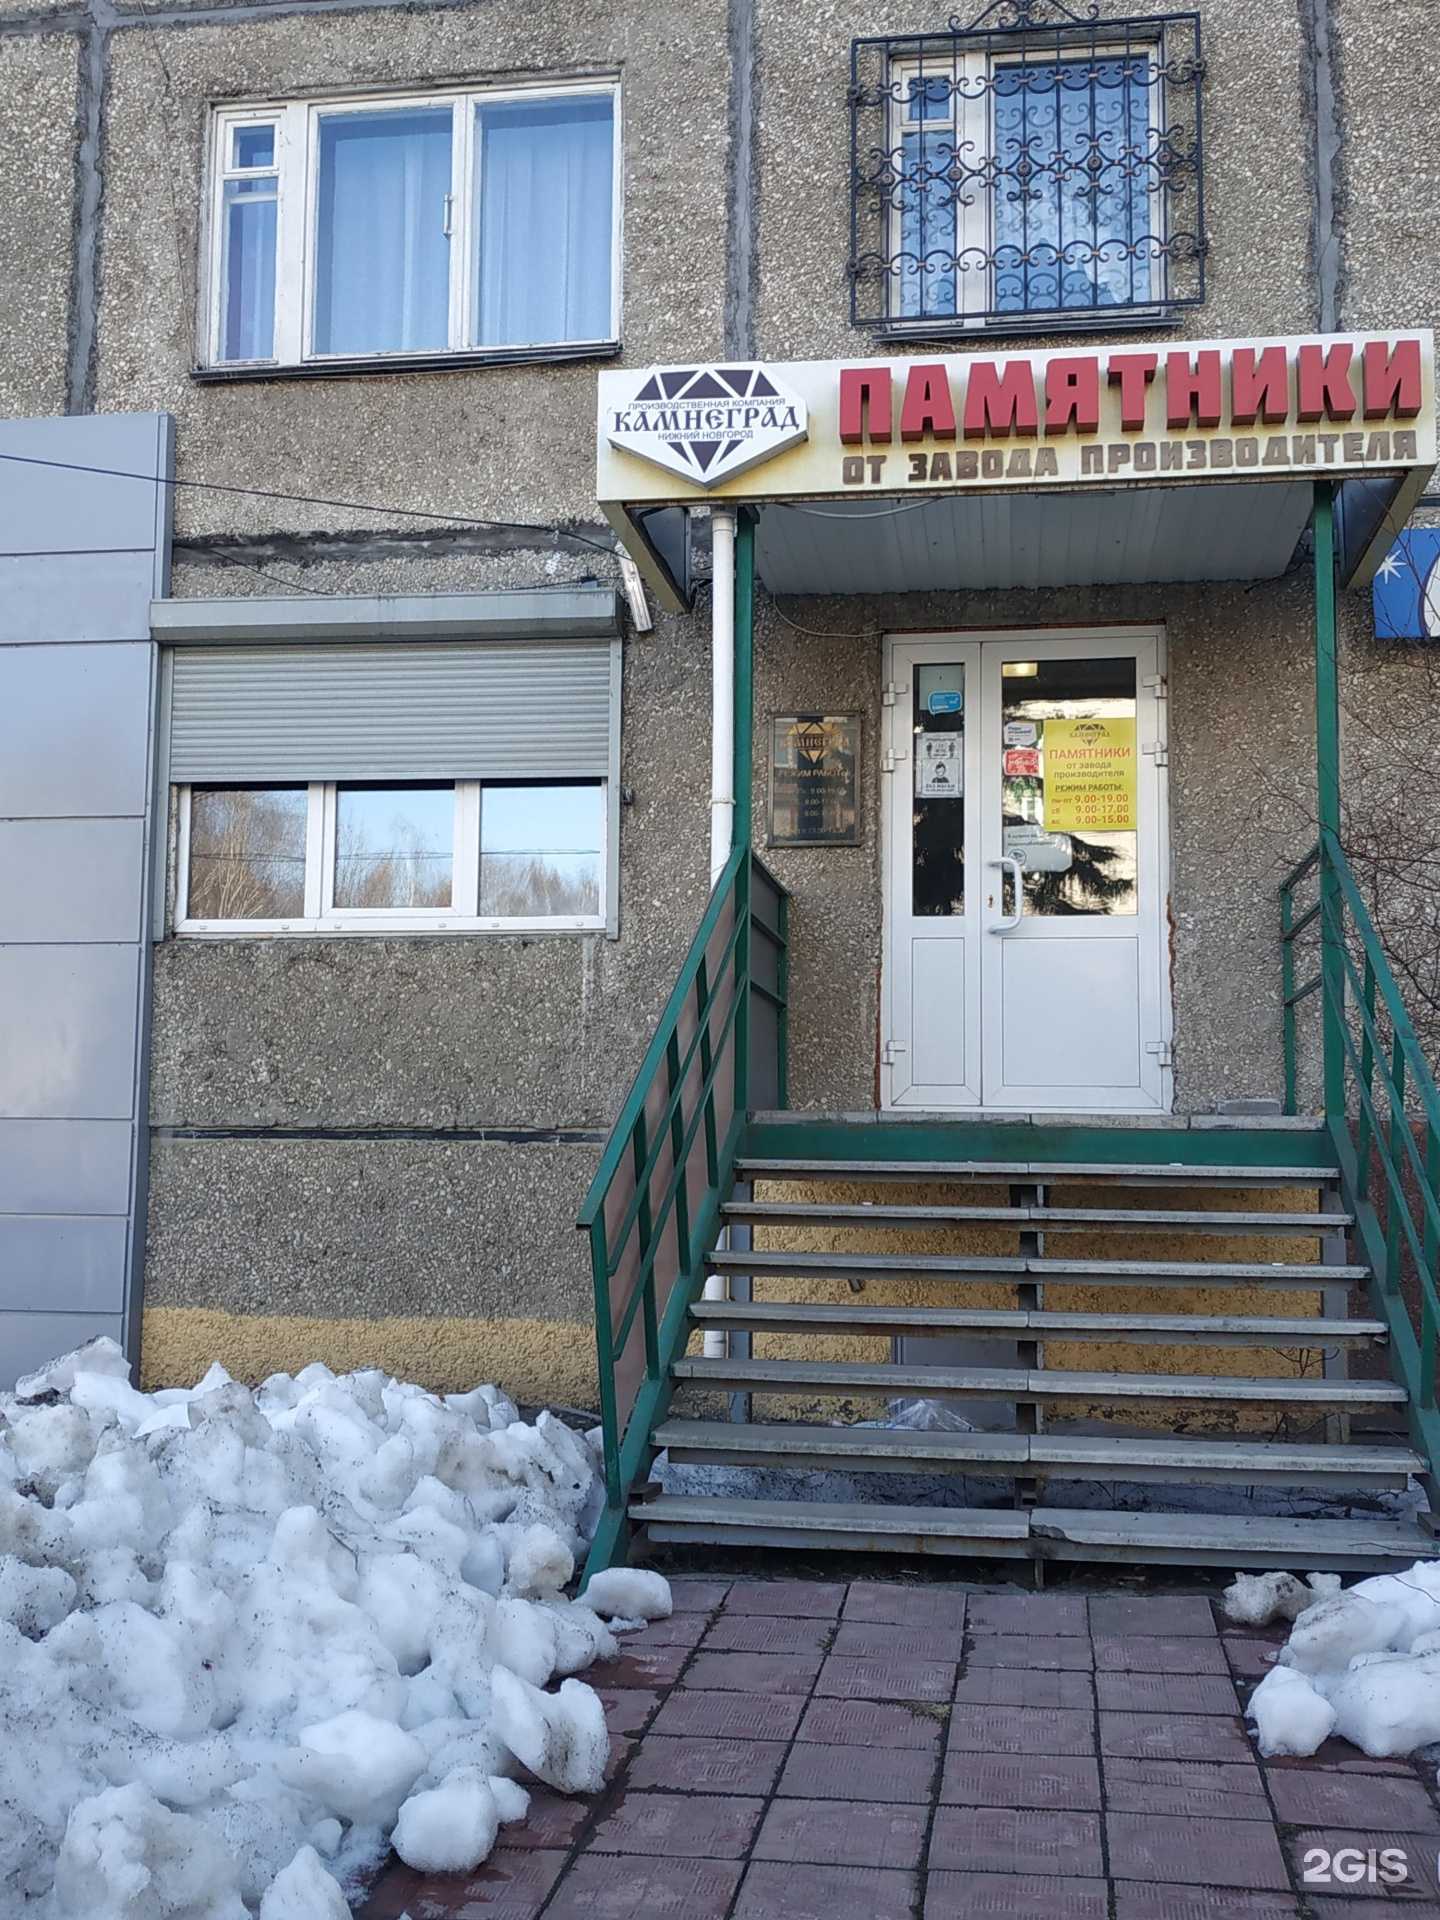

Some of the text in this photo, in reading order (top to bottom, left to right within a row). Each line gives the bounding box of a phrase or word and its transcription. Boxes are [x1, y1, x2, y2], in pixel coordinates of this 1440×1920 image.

[839, 340, 1422, 445] ПАМЯТНИКИ
[627, 397, 786, 410] ПРОИЗВОДСТВЕННАЯ КОМПАНИЯ
[613, 405, 800, 433] КАМНЕГРАД
[657, 429, 754, 441] НИЖНИЙ НОВГОРОД
[842, 429, 1418, 486] ОТ ЗАВОДА ПРОИЗВОДИТЕЛЯ
[1049, 747, 1131, 760] ПАМЯТНИКИ
[1079, 761, 1112, 770] завода
[1054, 770, 1125, 780] производителя
[1055, 784, 1086, 792] РЕЖИМ
[1074, 793, 1129, 803] 9.00-19.00
[1075, 804, 1129, 814] 9.00-17.00
[1075, 814, 1129, 824] 9.00-15.00
